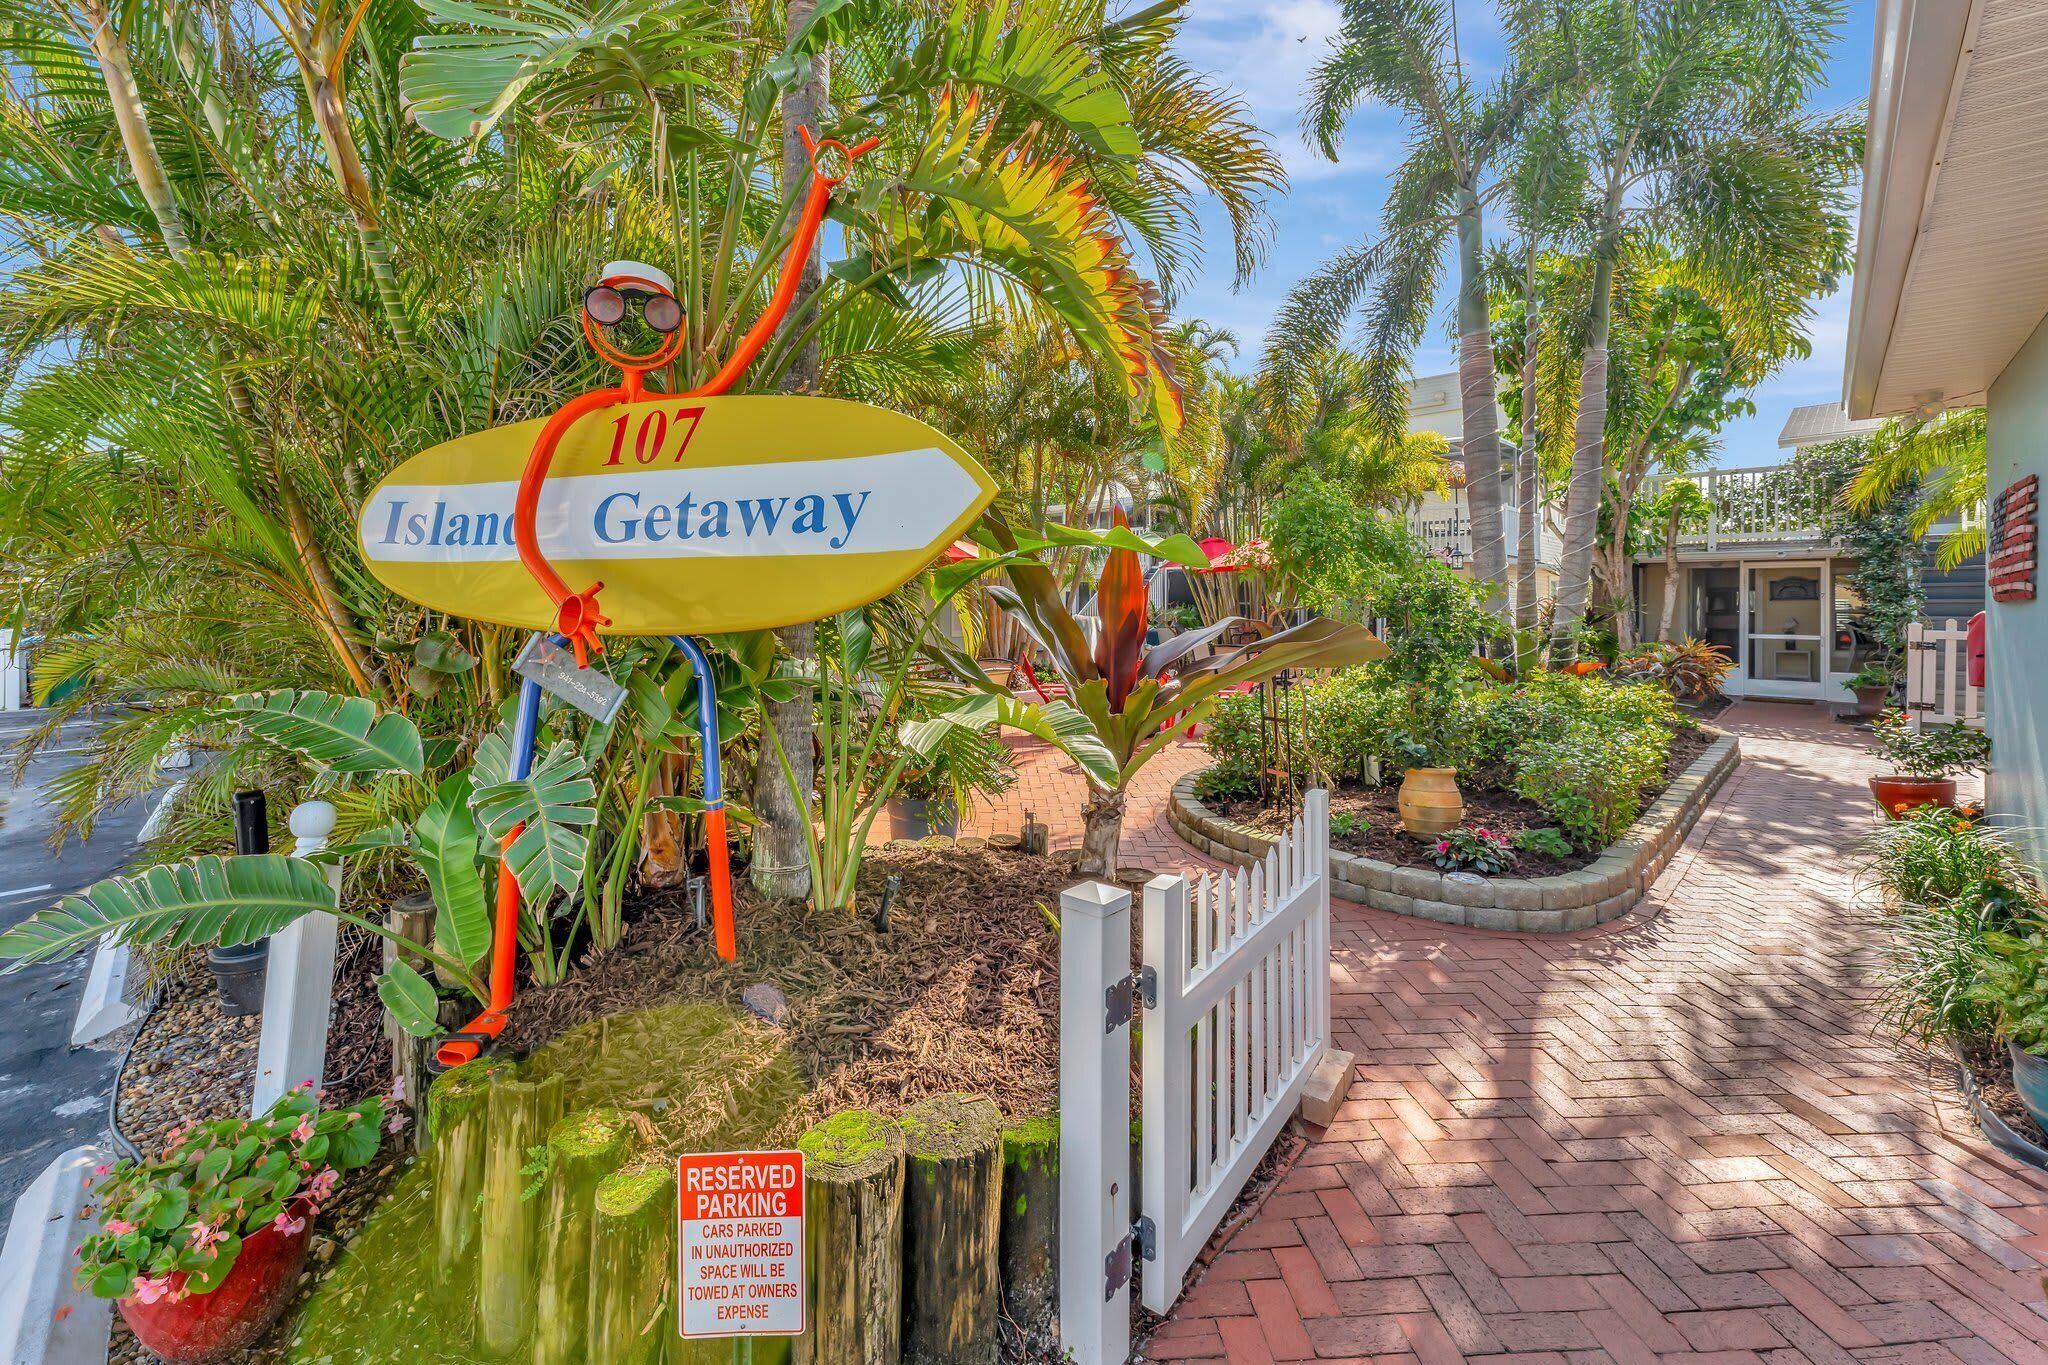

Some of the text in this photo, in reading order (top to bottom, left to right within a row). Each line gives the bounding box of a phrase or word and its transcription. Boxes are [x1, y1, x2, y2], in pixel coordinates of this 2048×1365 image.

[601, 406, 706, 467] 107
[593, 491, 872, 549] Getaway
[686, 1164, 796, 1192] RESERVED
[697, 1191, 787, 1218] PARKING
[702, 1222, 782, 1239] CARS PARKED
[691, 1242, 793, 1260] IN UNAUTHORIZED
[700, 1263, 785, 1280] SPACE WILL BE
[688, 1283, 797, 1301] TOWED AT OWNERS
[717, 1304, 769, 1320] EXPENSE
